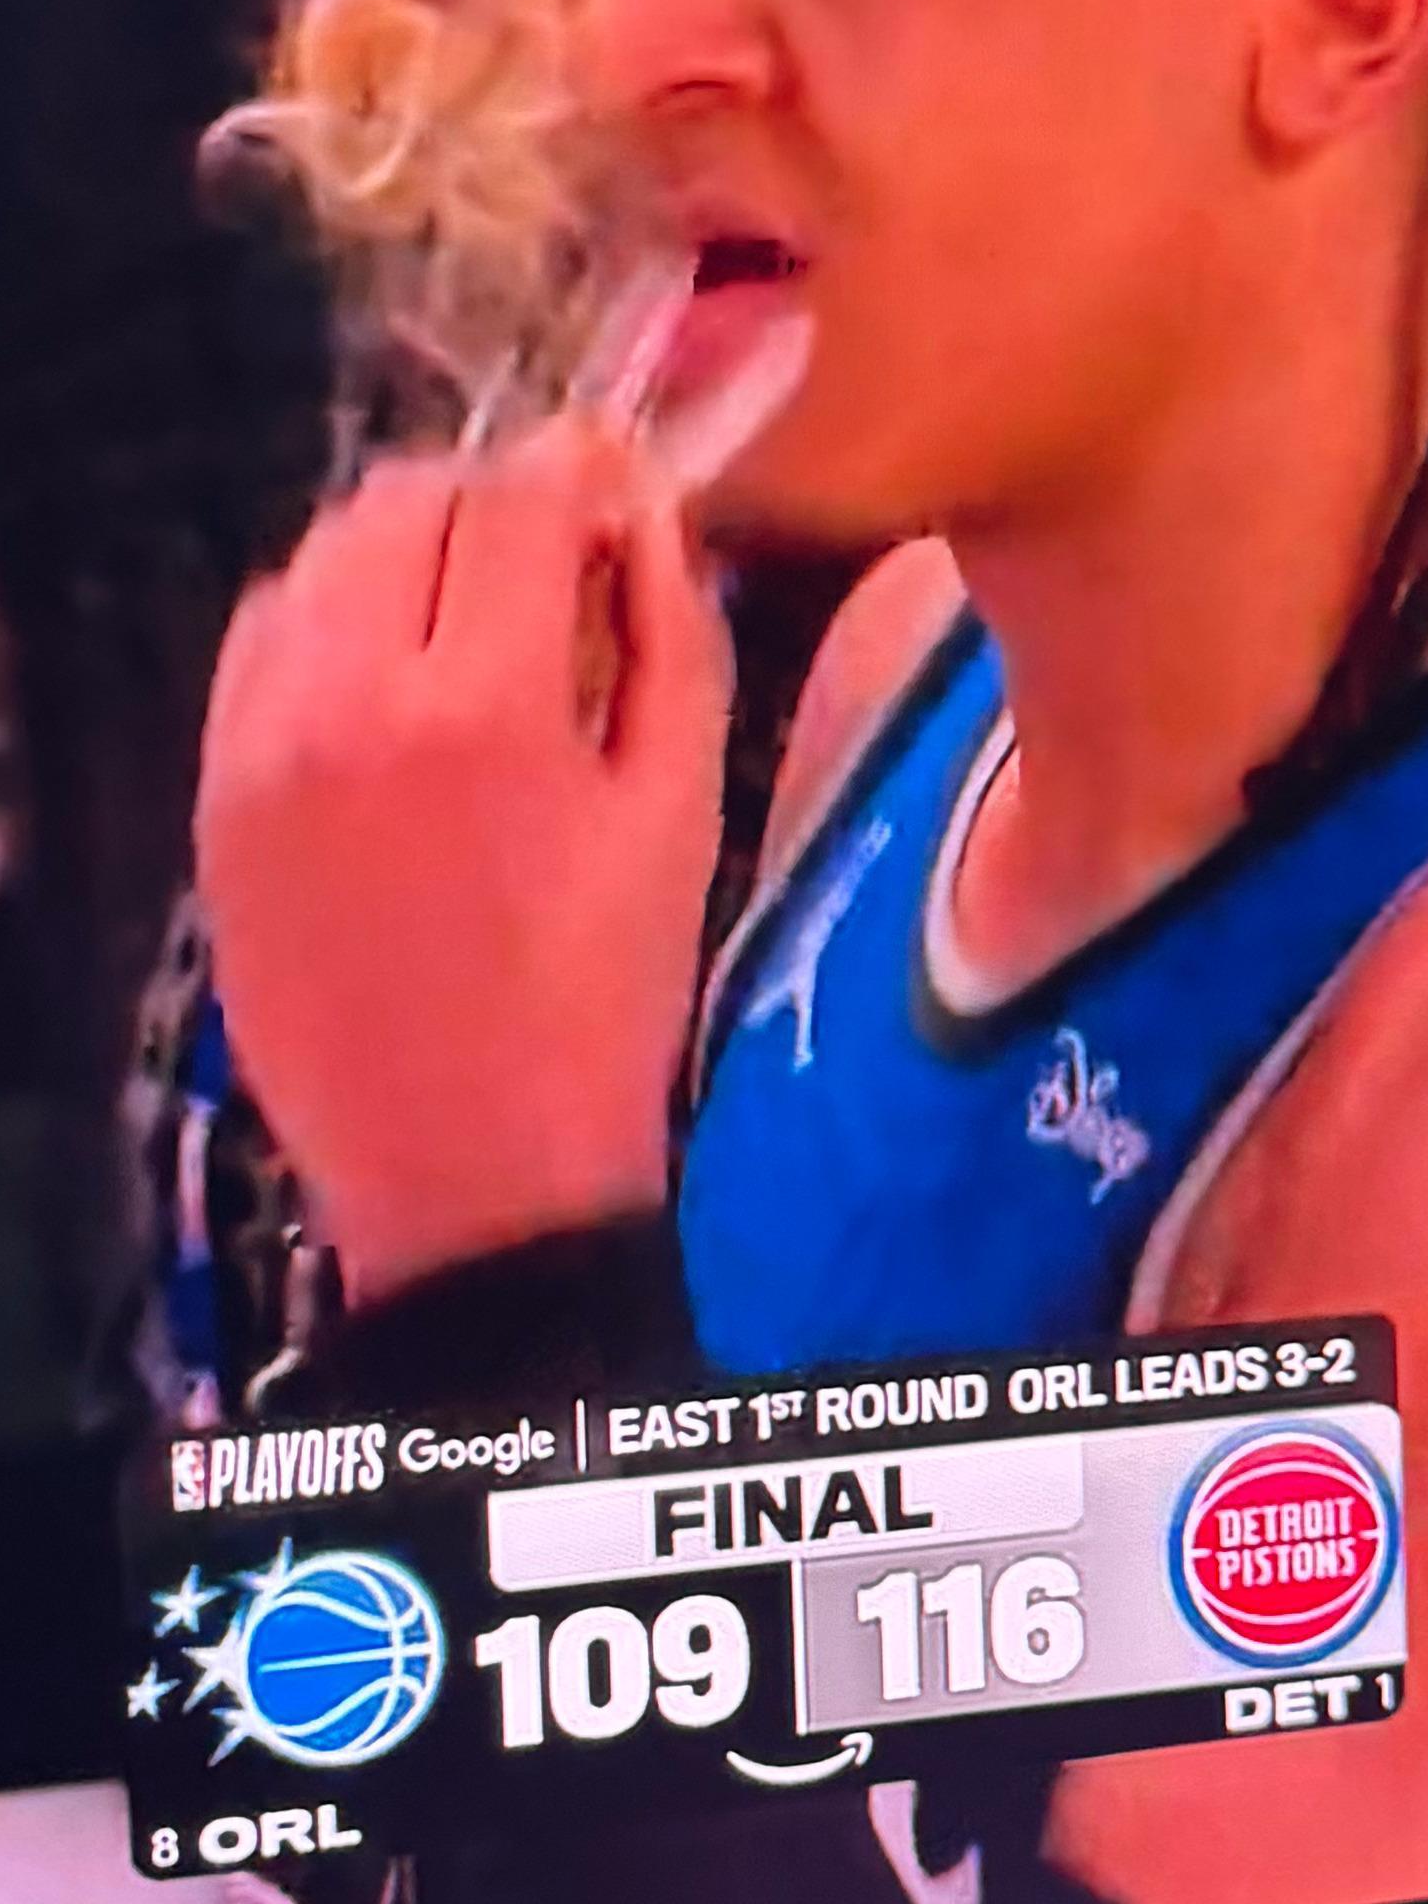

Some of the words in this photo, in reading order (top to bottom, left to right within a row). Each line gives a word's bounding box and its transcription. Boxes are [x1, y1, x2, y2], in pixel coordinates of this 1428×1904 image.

[608, 1397, 740, 1456] EAST
[747, 1390, 807, 1442] 1ST
[815, 1373, 990, 1435] ROUND
[1008, 1362, 1108, 1415] ORL
[1115, 1345, 1269, 1404] LEADS
[1274, 1337, 1358, 1389] 3-2
[208, 1422, 387, 1507] PLAYOFFS
[398, 1416, 556, 1475] Google
[652, 1465, 934, 1558] FINAL
[1214, 1494, 1357, 1548] DETROIT
[1214, 1537, 1358, 1591] PISTONS
[474, 1593, 752, 1749] 109
[856, 1554, 1086, 1701] 116
[1223, 1673, 1362, 1735] DET
[1374, 1671, 1397, 1711] 1
[150, 1826, 180, 1869] 8
[198, 1802, 364, 1866] ORL
